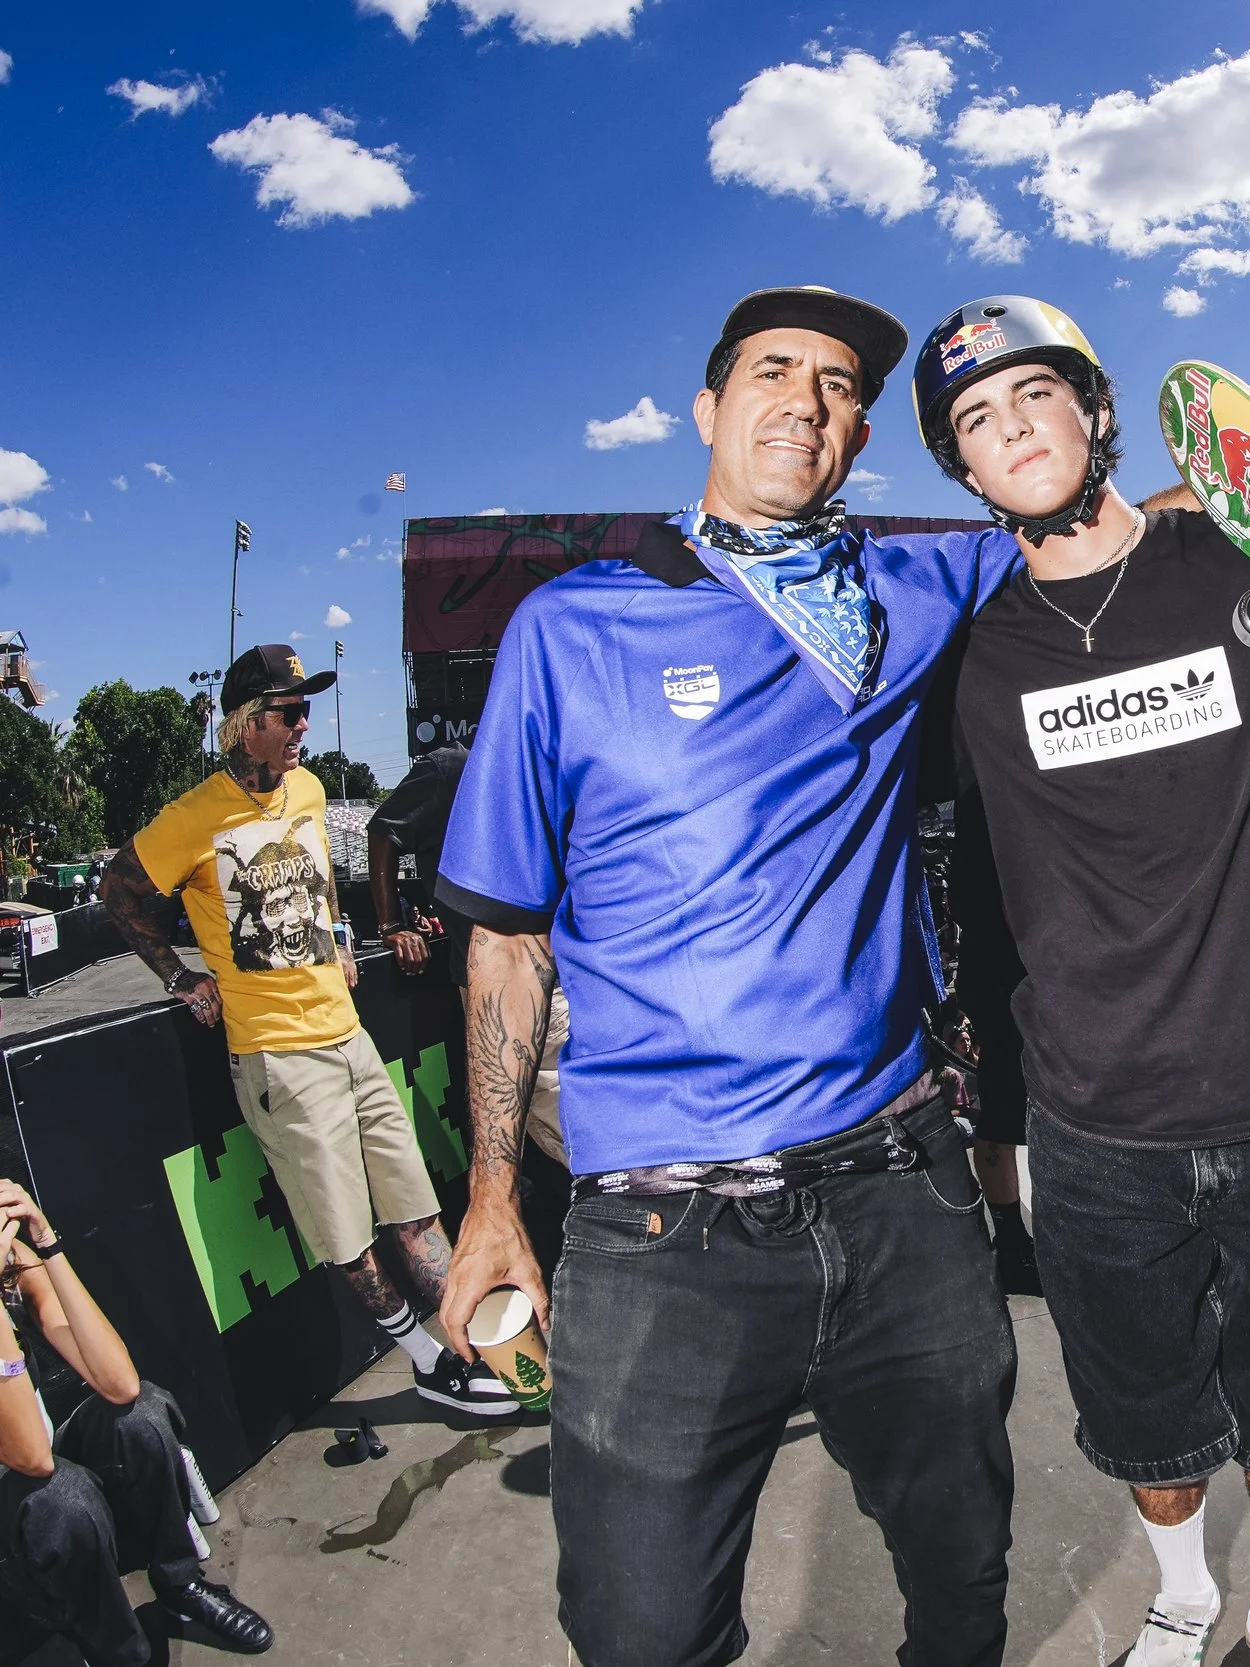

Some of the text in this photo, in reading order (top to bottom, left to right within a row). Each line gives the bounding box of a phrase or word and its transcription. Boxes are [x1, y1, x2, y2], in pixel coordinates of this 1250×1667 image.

[943, 333, 1006, 374] Red Bull
[1186, 368, 1211, 482] Red Bull
[673, 664, 714, 676] MoonPay
[1038, 686, 1169, 733] adidas
[1043, 701, 1224, 756] SKATEBOARDING
[248, 854, 314, 892] CRAMPS
